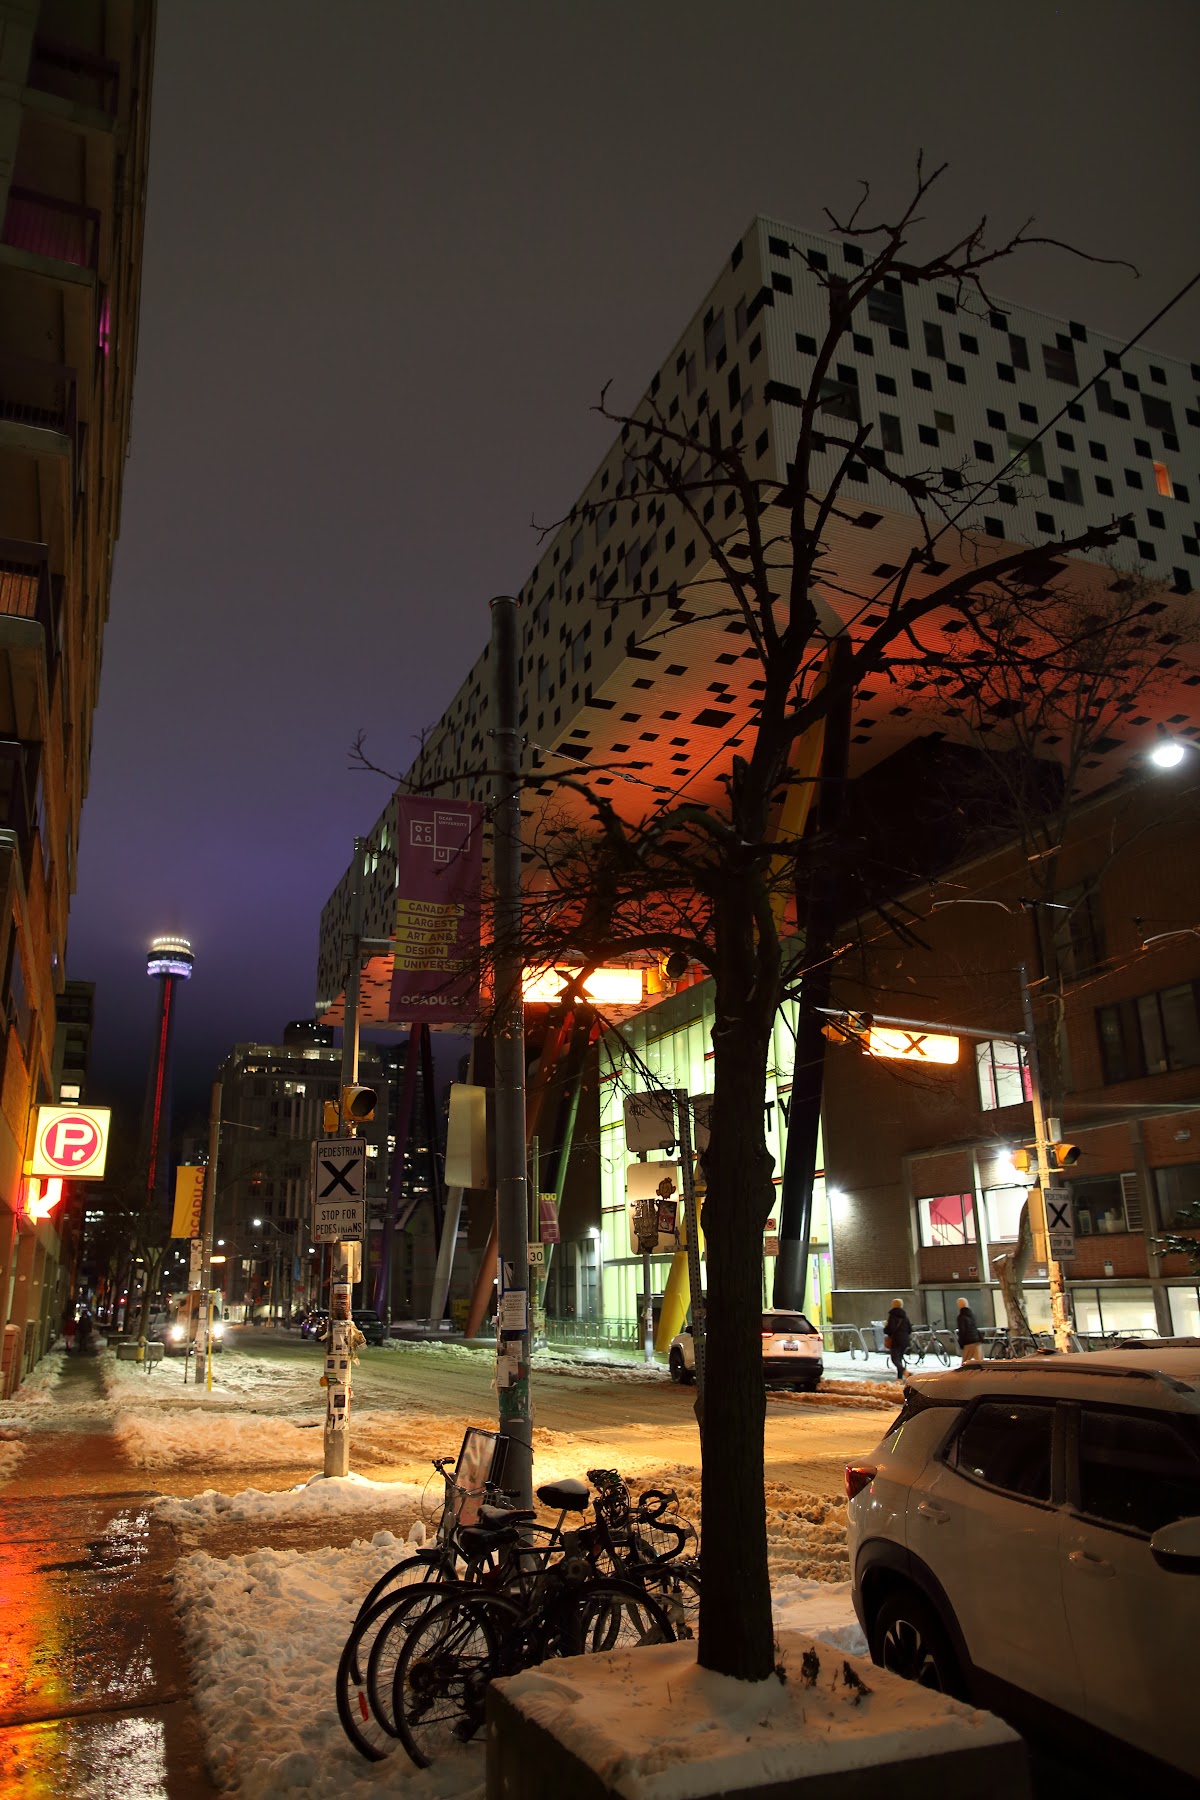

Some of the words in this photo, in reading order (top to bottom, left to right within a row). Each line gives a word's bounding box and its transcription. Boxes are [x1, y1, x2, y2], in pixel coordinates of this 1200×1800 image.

[407, 917, 455, 928] LARGEST
[406, 931, 425, 940] ART
[428, 933, 453, 941] AND
[405, 946, 444, 955] DESIGN
[318, 1146, 363, 1157] PEDESTRIAN
[540, 1192, 558, 1201] 100
[321, 1210, 340, 1221] STOP
[342, 1208, 357, 1219] FOR
[530, 1251, 543, 1262] 30
